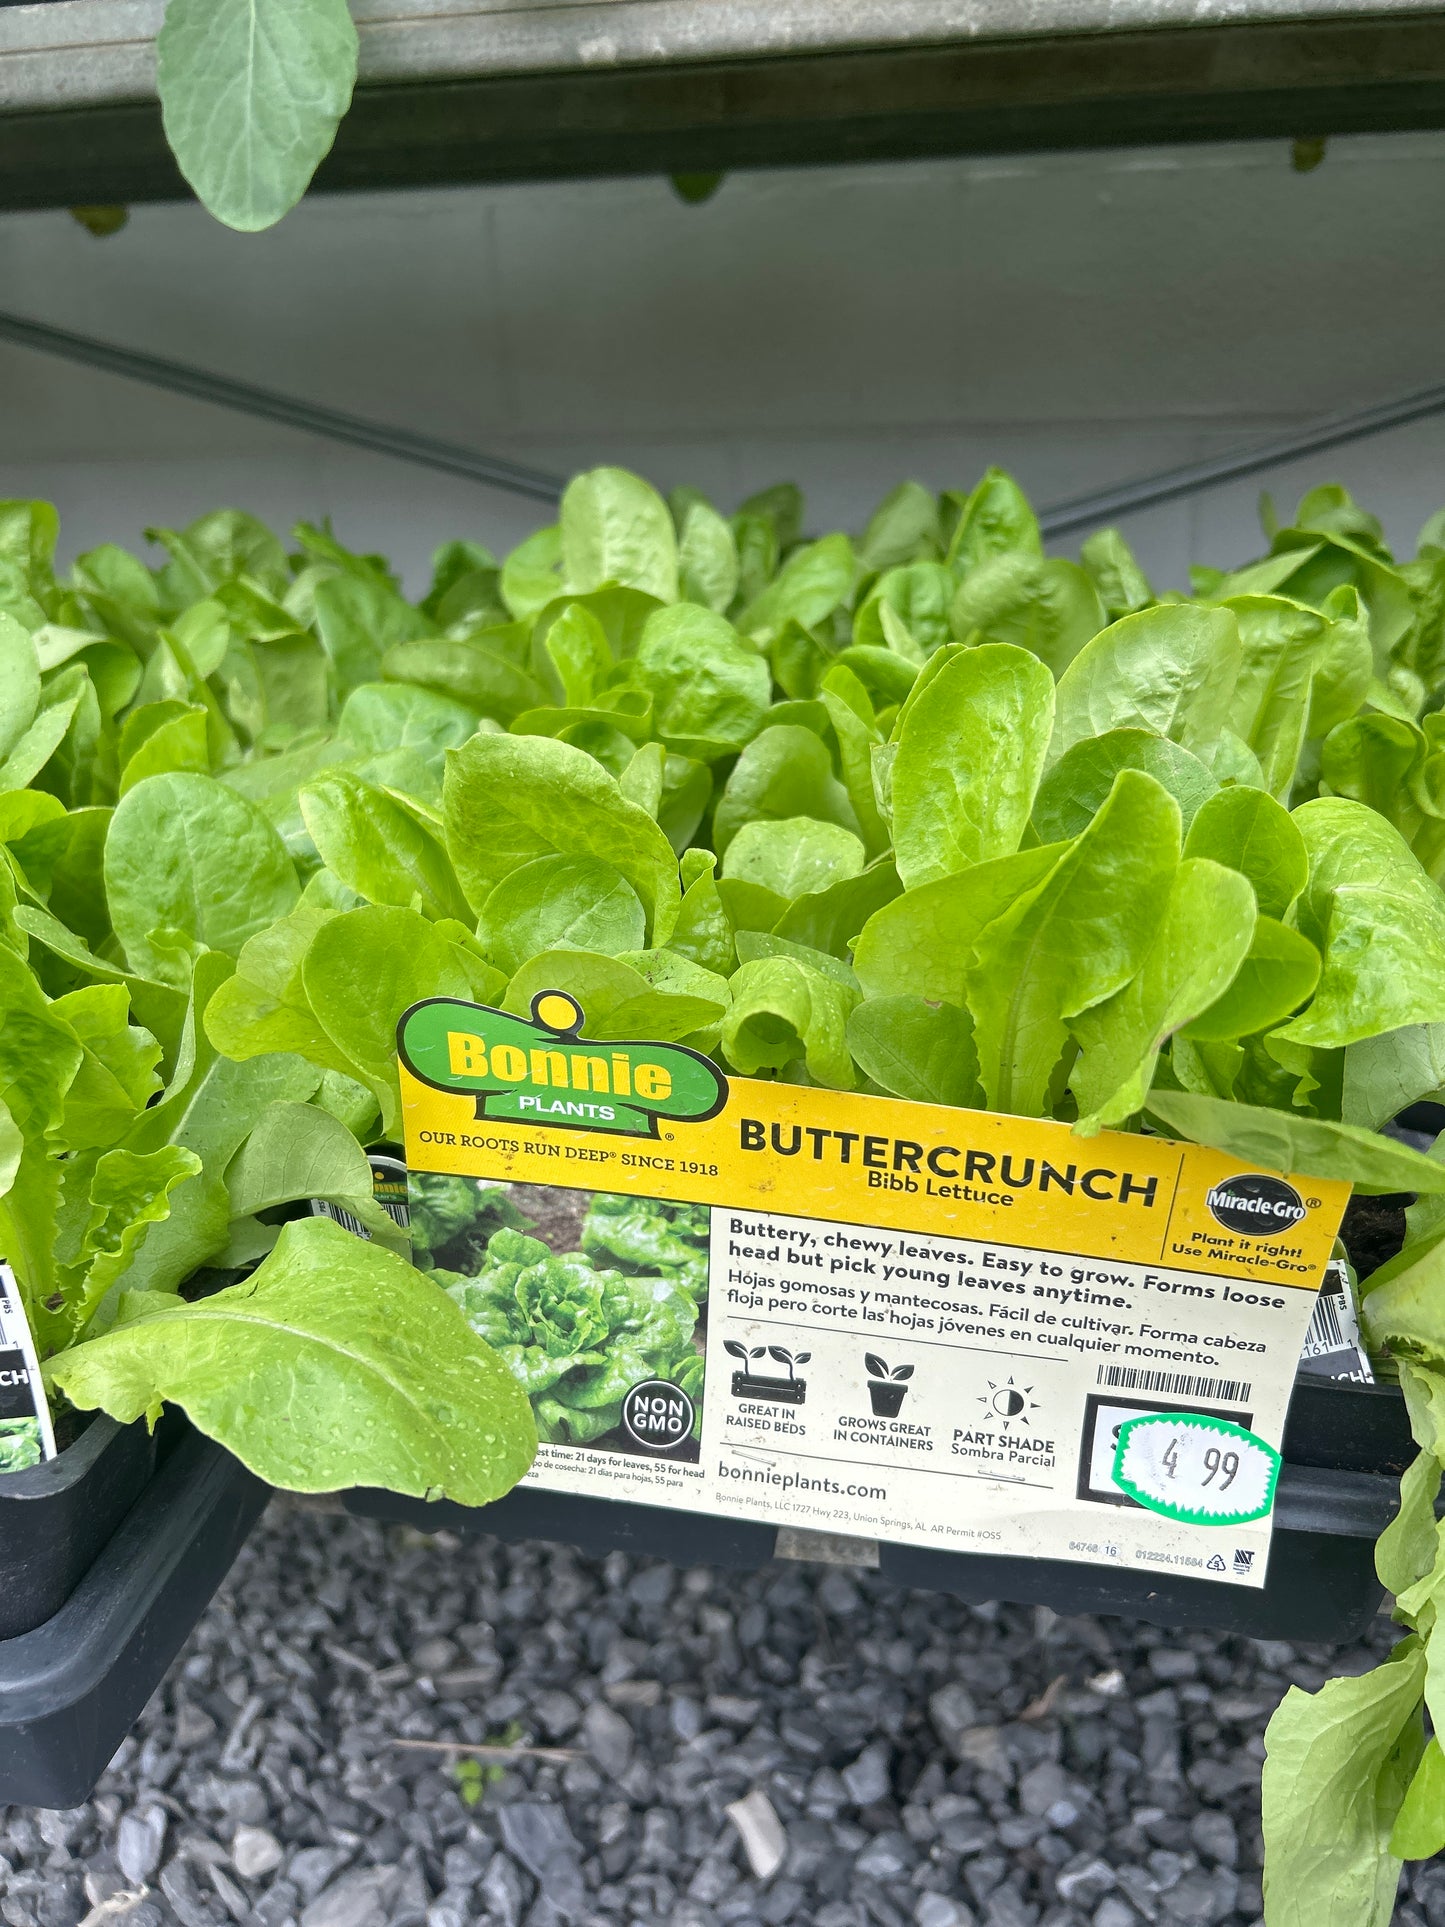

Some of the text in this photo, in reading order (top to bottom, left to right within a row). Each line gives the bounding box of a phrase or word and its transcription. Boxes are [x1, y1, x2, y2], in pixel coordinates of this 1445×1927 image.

[447, 1031, 672, 1100] Bonnie
[519, 1095, 616, 1121] PLANTS
[419, 1130, 457, 1146] OUR
[461, 1135, 520, 1153] ROOTS
[524, 1141, 561, 1158] RUN
[621, 1153, 675, 1171] SINCE
[680, 1160, 719, 1177] 1918
[740, 1118, 1158, 1208] BUTTERCRUNCH
[868, 1170, 1014, 1207] Bibb Lettuce
[1172, 1243, 1202, 1257] Use
[1191, 1232, 1303, 1258] Plant it right!
[729, 1240, 1133, 1309] head but pick young leaves anytime.
[730, 1217, 1286, 1309] Buttery, chewy leaves. Easy to grow. Forms loose
[728, 1268, 1267, 1353] Hojas gomosas y mantecosas. Fácil de cultivar. Forma cabeza
[1337, 1294, 1347, 1311] PBS
[727, 1288, 1220, 1366] floja pero corte las hojas jóvenes en cualquier momento.
[634, 1395, 684, 1417] NON
[738, 1403, 796, 1420] GREAT IN
[633, 1412, 682, 1432] GMO
[726, 1415, 807, 1436] RAISED BEDS
[838, 1416, 931, 1437] GROWS GREAT
[833, 1429, 934, 1451] IN CONTAINERS
[953, 1428, 1055, 1454] PART SHADE
[551, 1449, 574, 1460] time:
[575, 1452, 585, 1461] 21
[586, 1454, 607, 1466] days
[608, 1457, 622, 1467] for
[623, 1458, 653, 1473] leaves,
[654, 1462, 666, 1472] 55
[668, 1465, 681, 1475] for
[683, 1467, 705, 1479] head
[951, 1443, 1056, 1468] Sombra Parcial
[1161, 1438, 1240, 1492] 4 99
[544, 1460, 553, 1469] de
[554, 1462, 587, 1473] cosecha:
[588, 1466, 597, 1475] 21
[613, 1470, 631, 1480] para
[632, 1472, 654, 1484] hojas,
[655, 1475, 665, 1484] 55
[666, 1479, 683, 1487] para
[718, 1461, 887, 1500] bonnieplants.com
[715, 1492, 744, 1504] Bonnie
[745, 1494, 773, 1509] Plants,
[774, 1501, 791, 1511] LLC
[792, 1503, 811, 1514] 1727
[812, 1507, 831, 1518] Hwy
[833, 1510, 851, 1520] 223,
[853, 1512, 878, 1524] Union
[880, 1516, 913, 1530] Springs,
[914, 1522, 927, 1531] AL
[930, 1523, 944, 1534] AR
[946, 1526, 975, 1538] Permit
